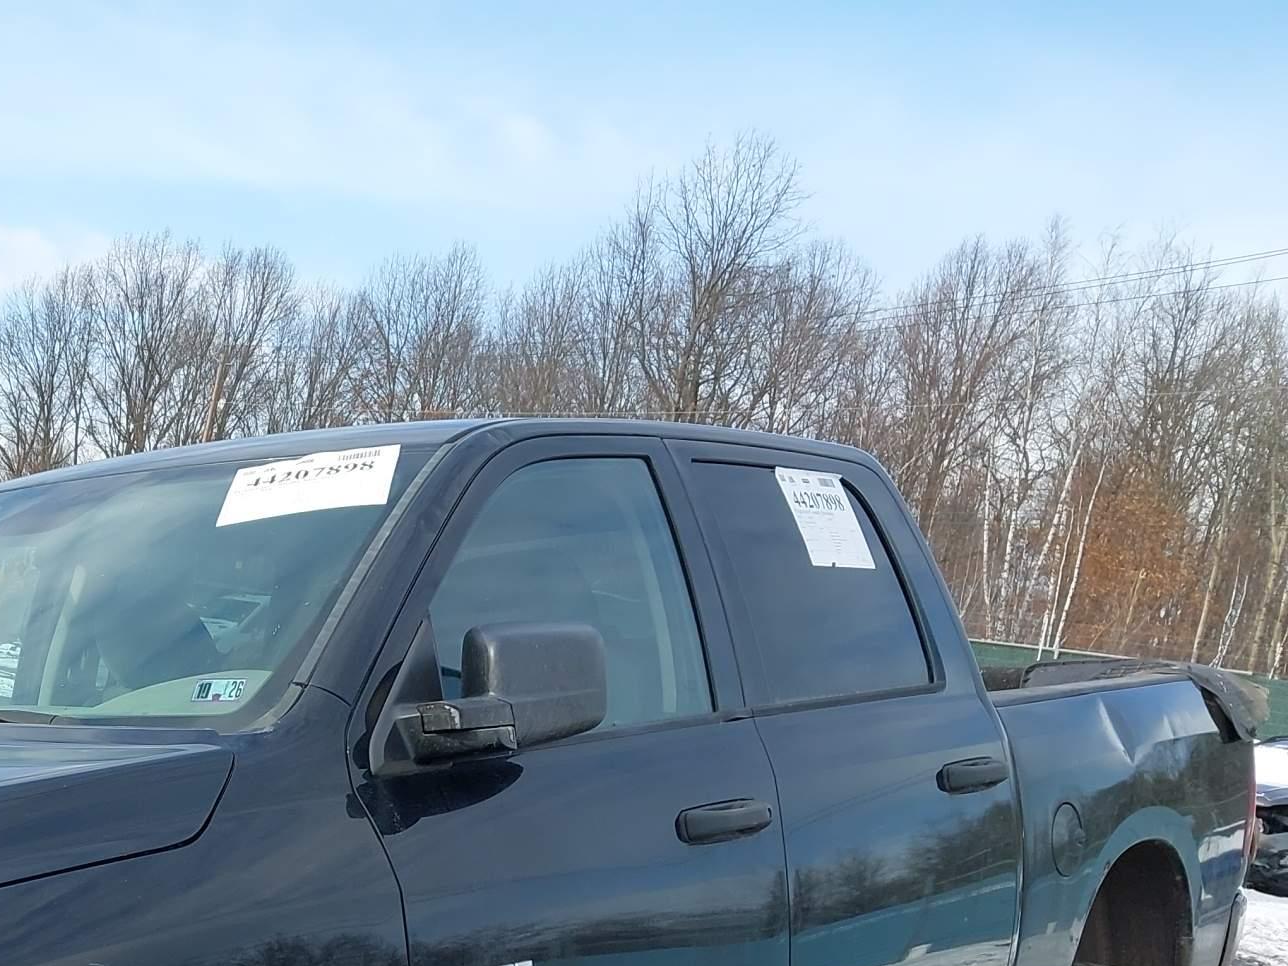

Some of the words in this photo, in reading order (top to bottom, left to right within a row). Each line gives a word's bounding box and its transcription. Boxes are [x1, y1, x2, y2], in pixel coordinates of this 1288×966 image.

[247, 460, 375, 487] 44207898
[792, 490, 845, 511] 44207898
[228, 681, 244, 698] 26
